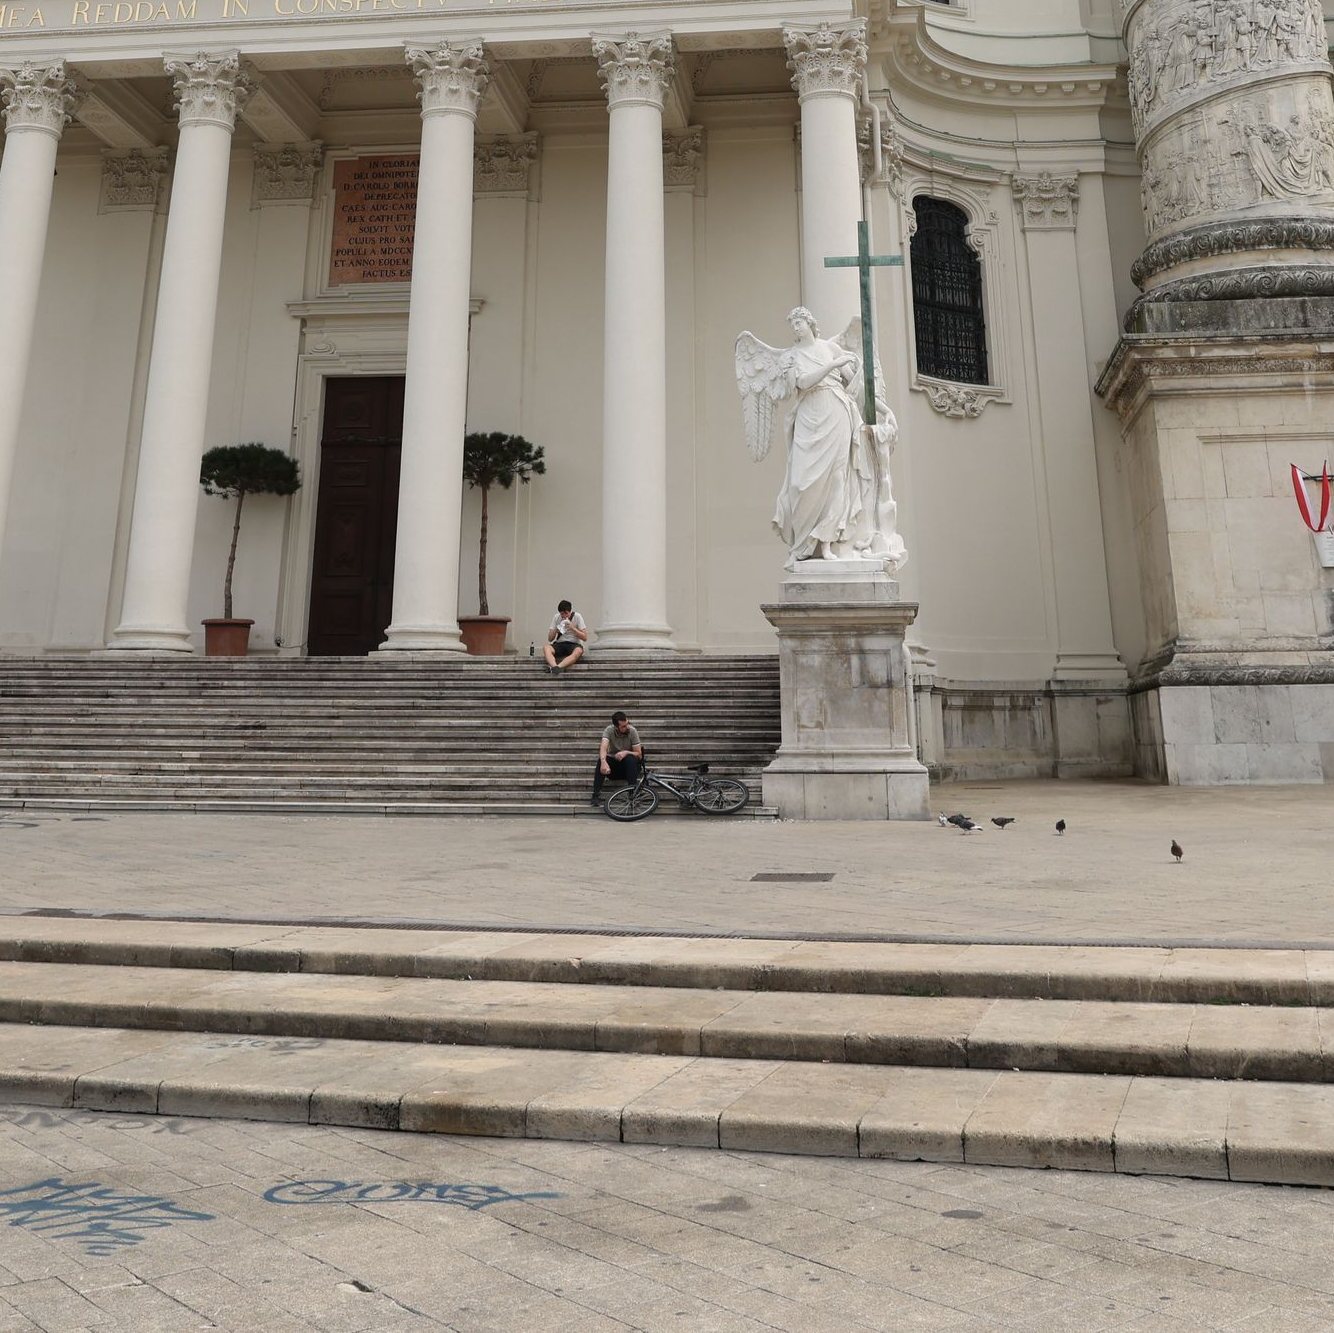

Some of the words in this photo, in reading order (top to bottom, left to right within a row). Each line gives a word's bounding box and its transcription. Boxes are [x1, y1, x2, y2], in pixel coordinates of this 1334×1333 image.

[72, 0, 198, 25] REDDAM
[372, 171, 419, 179] OMNIPOTE
[349, 259, 375, 267] ANNO
[379, 258, 409, 266] EODEM
[362, 270, 396, 278] FACTUS
[400, 269, 412, 277] ES
